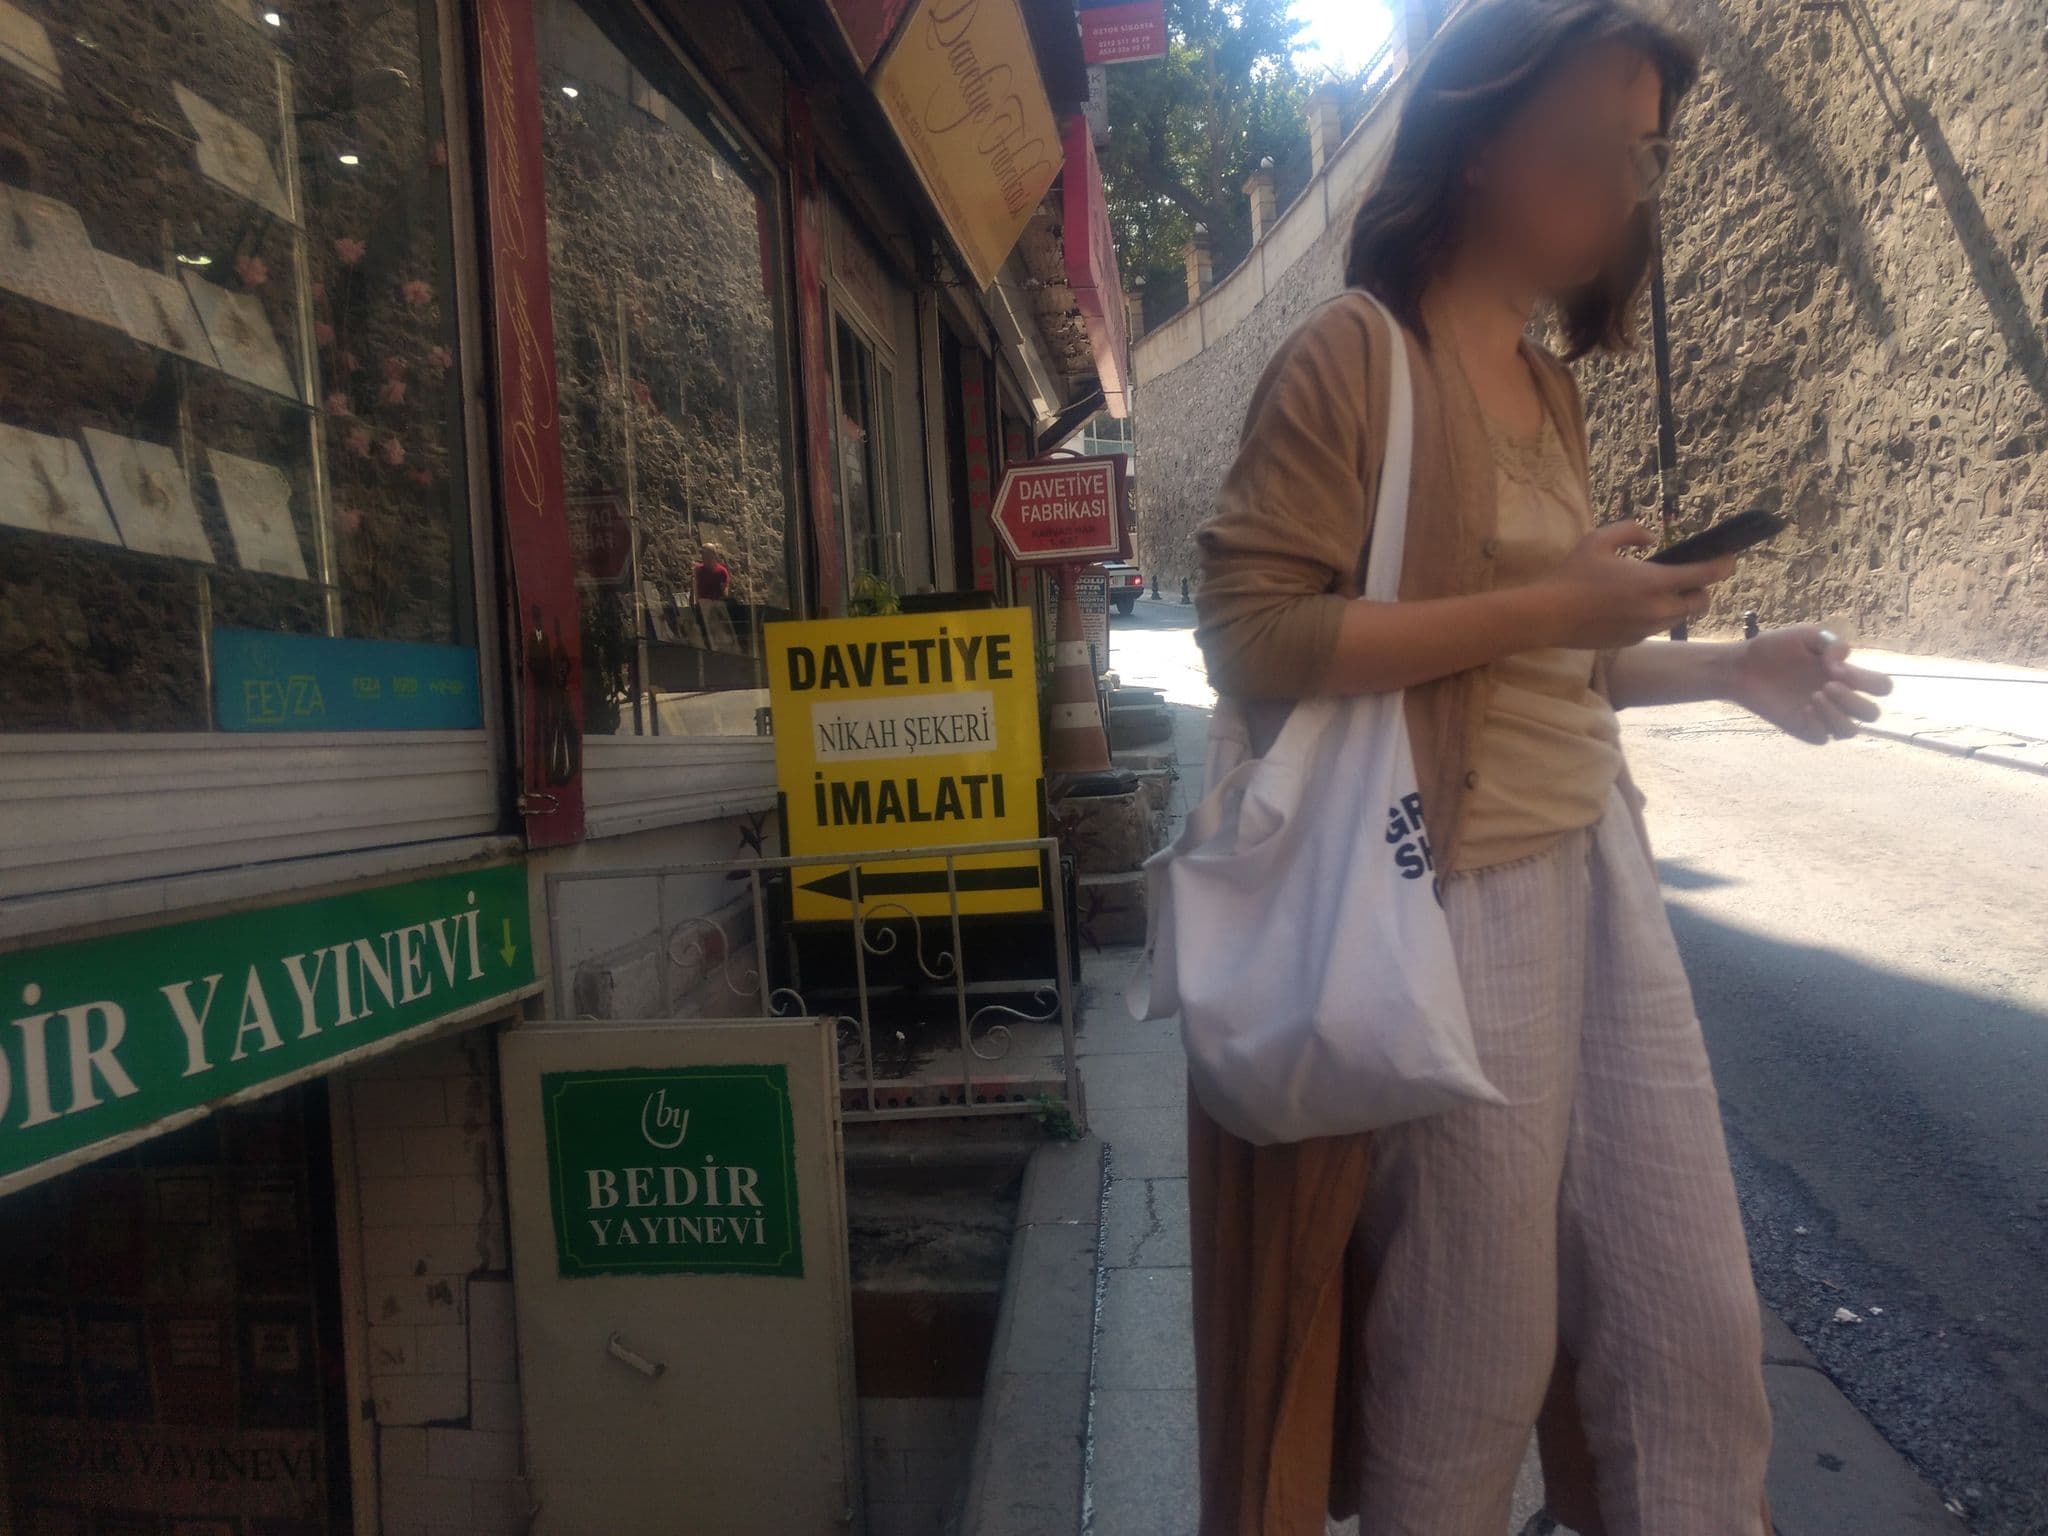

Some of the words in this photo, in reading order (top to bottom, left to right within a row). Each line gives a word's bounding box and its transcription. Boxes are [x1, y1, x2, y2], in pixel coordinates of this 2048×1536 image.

[1019, 473, 1105, 501] DAVETİYE
[1021, 498, 1106, 524] FABRİKASI
[787, 626, 1013, 691] DAVETİYE
[818, 716, 897, 752] NİKAH
[904, 706, 990, 754] ŞEKERİ
[814, 771, 1006, 827] İMALATI
[0, 982, 140, 1130] İR
[160, 890, 485, 1078] YAYINEVİ
[584, 1154, 764, 1210] BEDİR
[588, 1210, 767, 1246] YAYINEVİ
